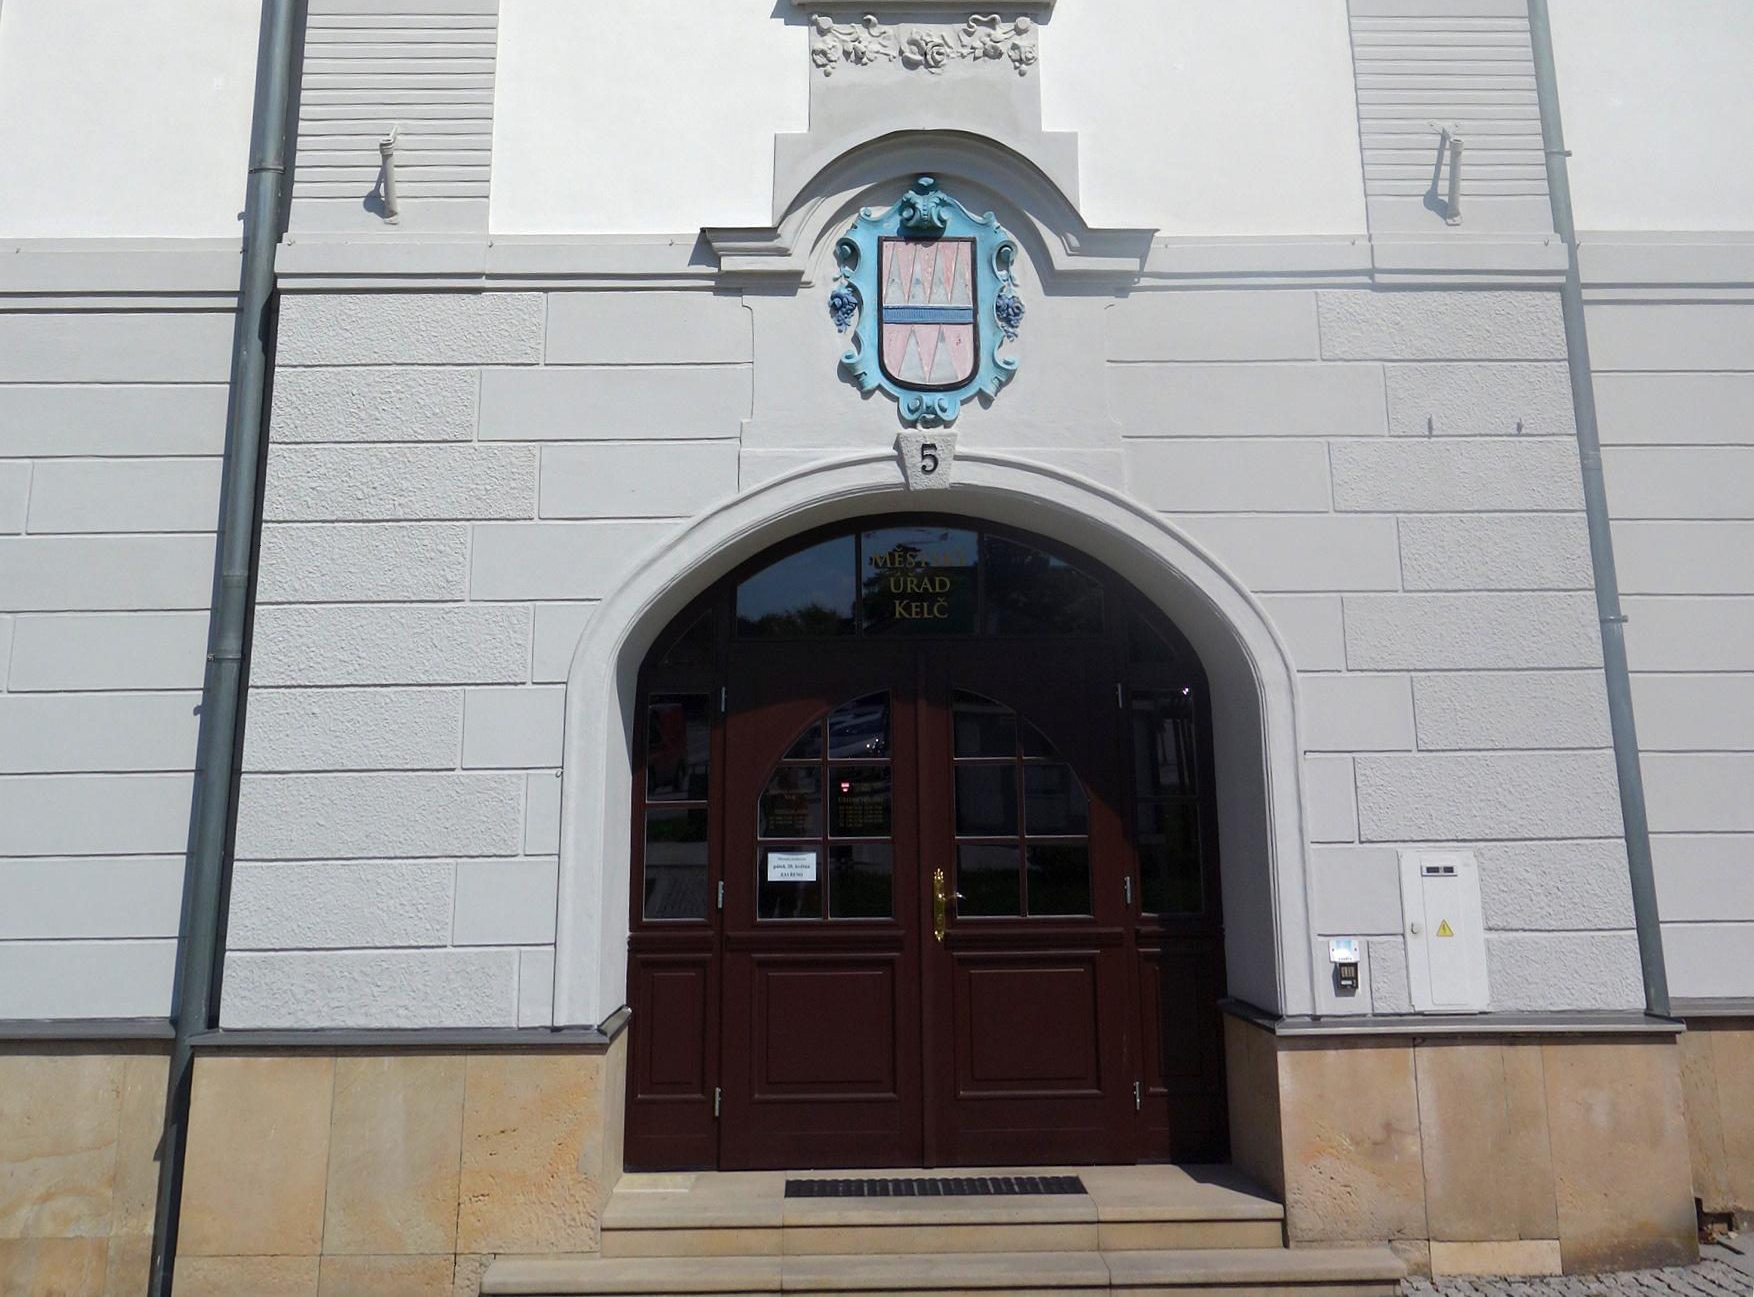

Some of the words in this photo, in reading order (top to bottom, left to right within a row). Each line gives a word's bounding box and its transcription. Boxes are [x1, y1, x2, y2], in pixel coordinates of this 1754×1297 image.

[920, 443, 939, 475] 5
[870, 548, 967, 568] MĚST
[889, 572, 951, 594] ÚŘAD
[893, 597, 949, 619] KELČ
